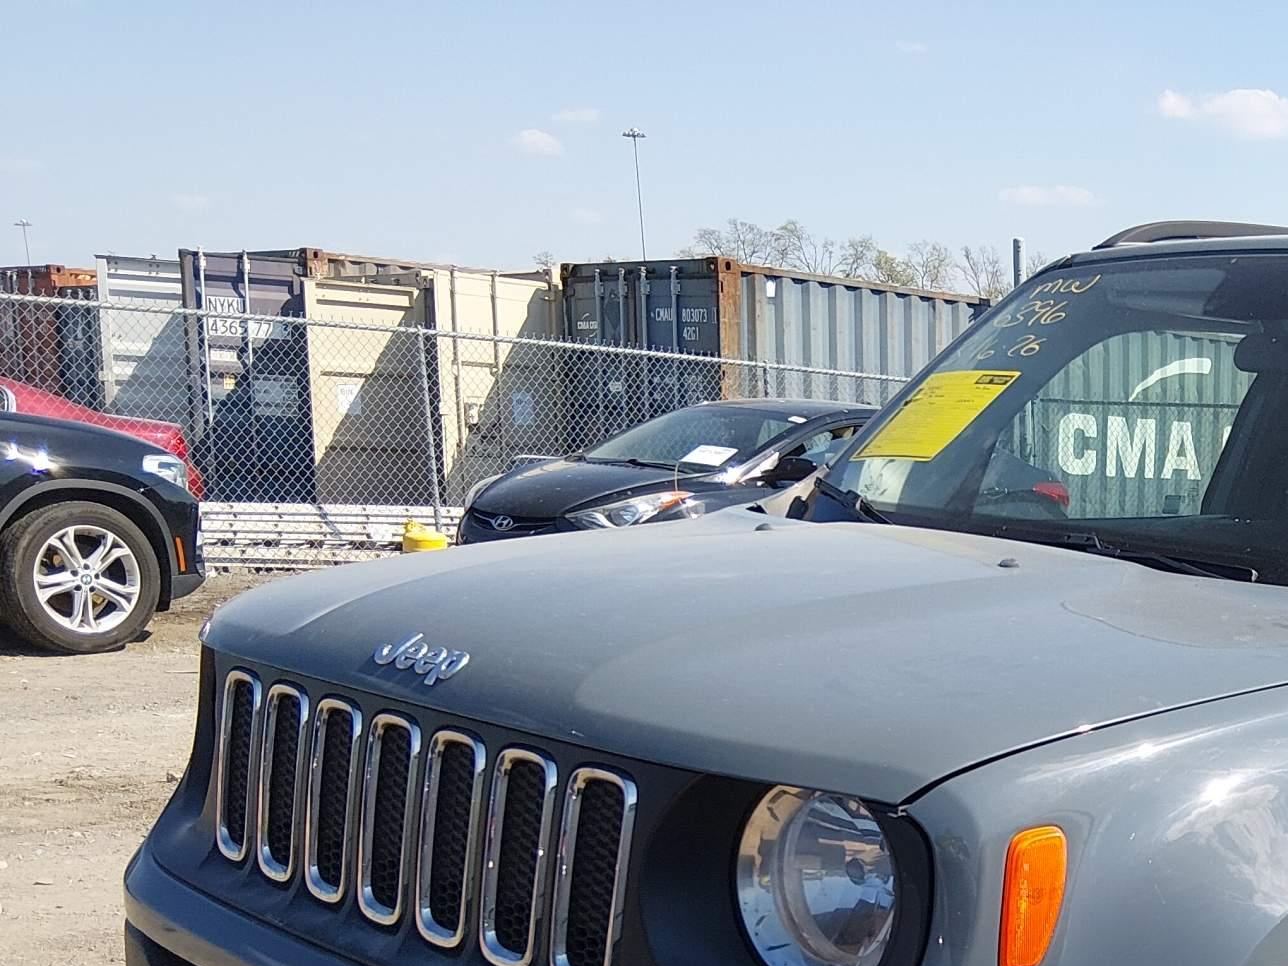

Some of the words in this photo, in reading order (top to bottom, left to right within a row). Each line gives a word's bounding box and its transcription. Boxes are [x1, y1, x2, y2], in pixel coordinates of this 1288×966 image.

[207, 297, 246, 313] NYKU
[681, 308, 708, 323] 803073
[1058, 412, 1202, 481] CMA
[374, 632, 471, 686] Jeep
